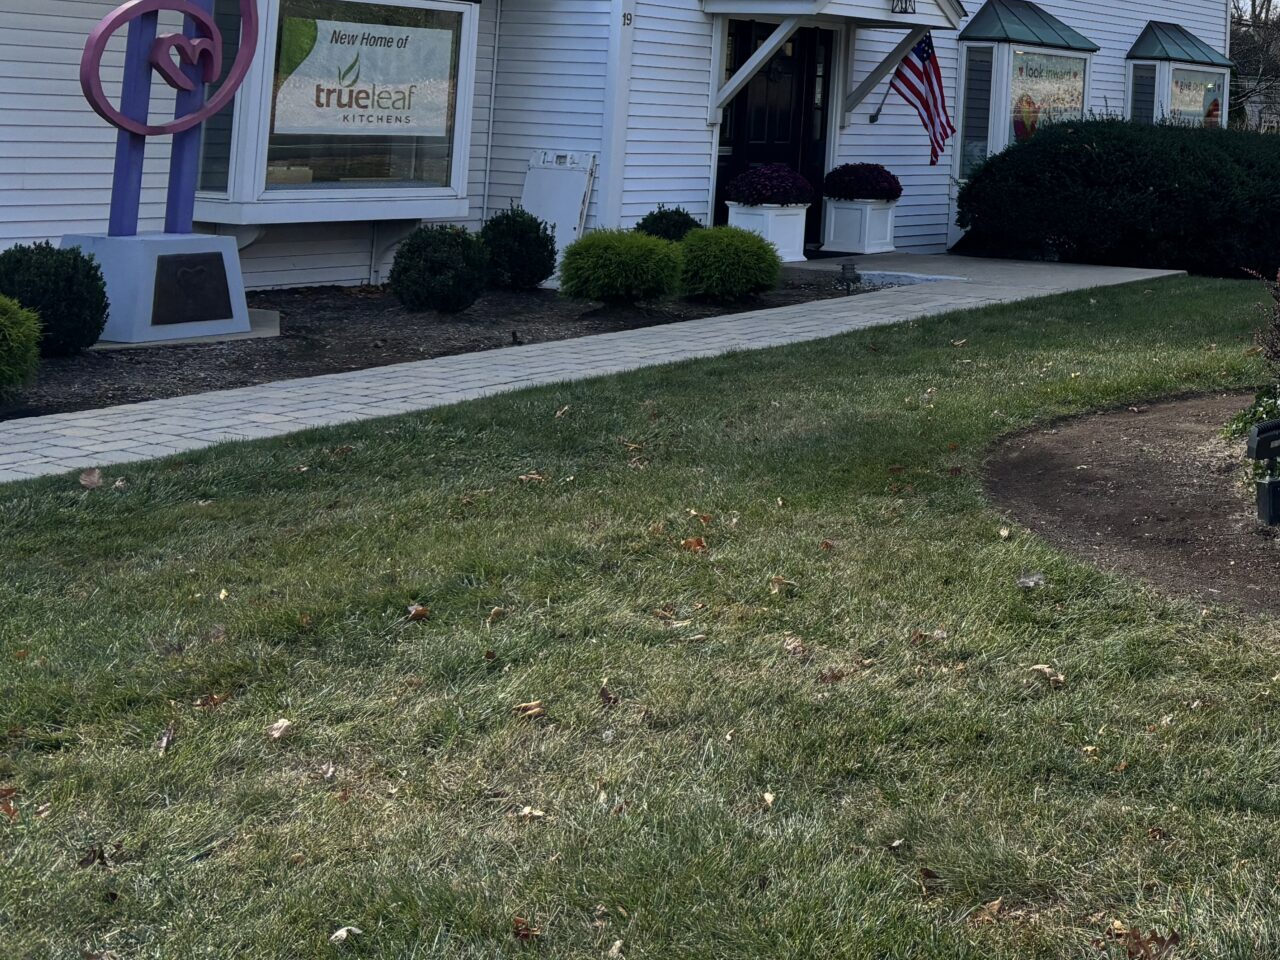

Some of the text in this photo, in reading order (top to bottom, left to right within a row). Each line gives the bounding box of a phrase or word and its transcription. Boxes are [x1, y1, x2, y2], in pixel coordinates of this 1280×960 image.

[622, 12, 633, 26] 19
[330, 30, 410, 49] New Home of
[1025, 62, 1044, 78] look
[315, 83, 417, 110] trueleaf
[342, 114, 412, 124] KITCHENS
